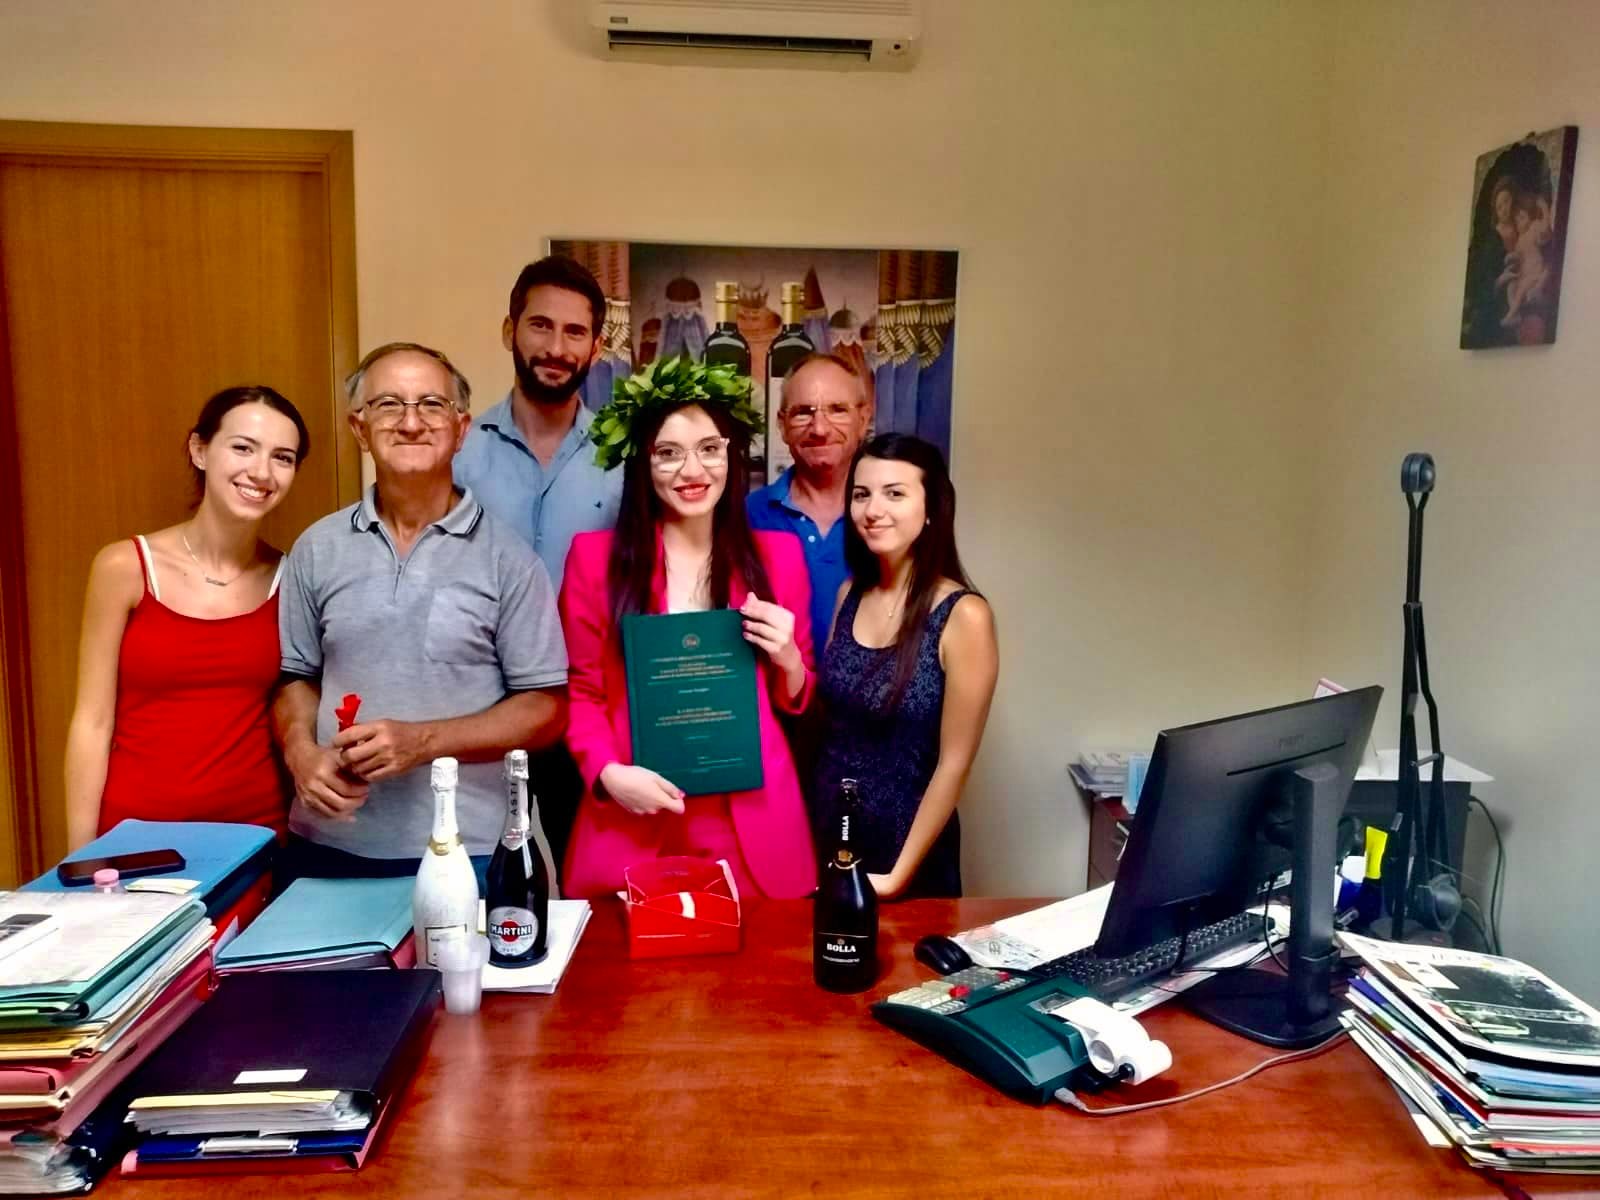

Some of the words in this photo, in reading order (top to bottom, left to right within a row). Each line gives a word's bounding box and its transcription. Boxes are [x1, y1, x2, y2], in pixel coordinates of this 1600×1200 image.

[510, 782, 519, 816] ASTI
[490, 923, 532, 936] MARTINI
[826, 943, 857, 953] BOLLA
